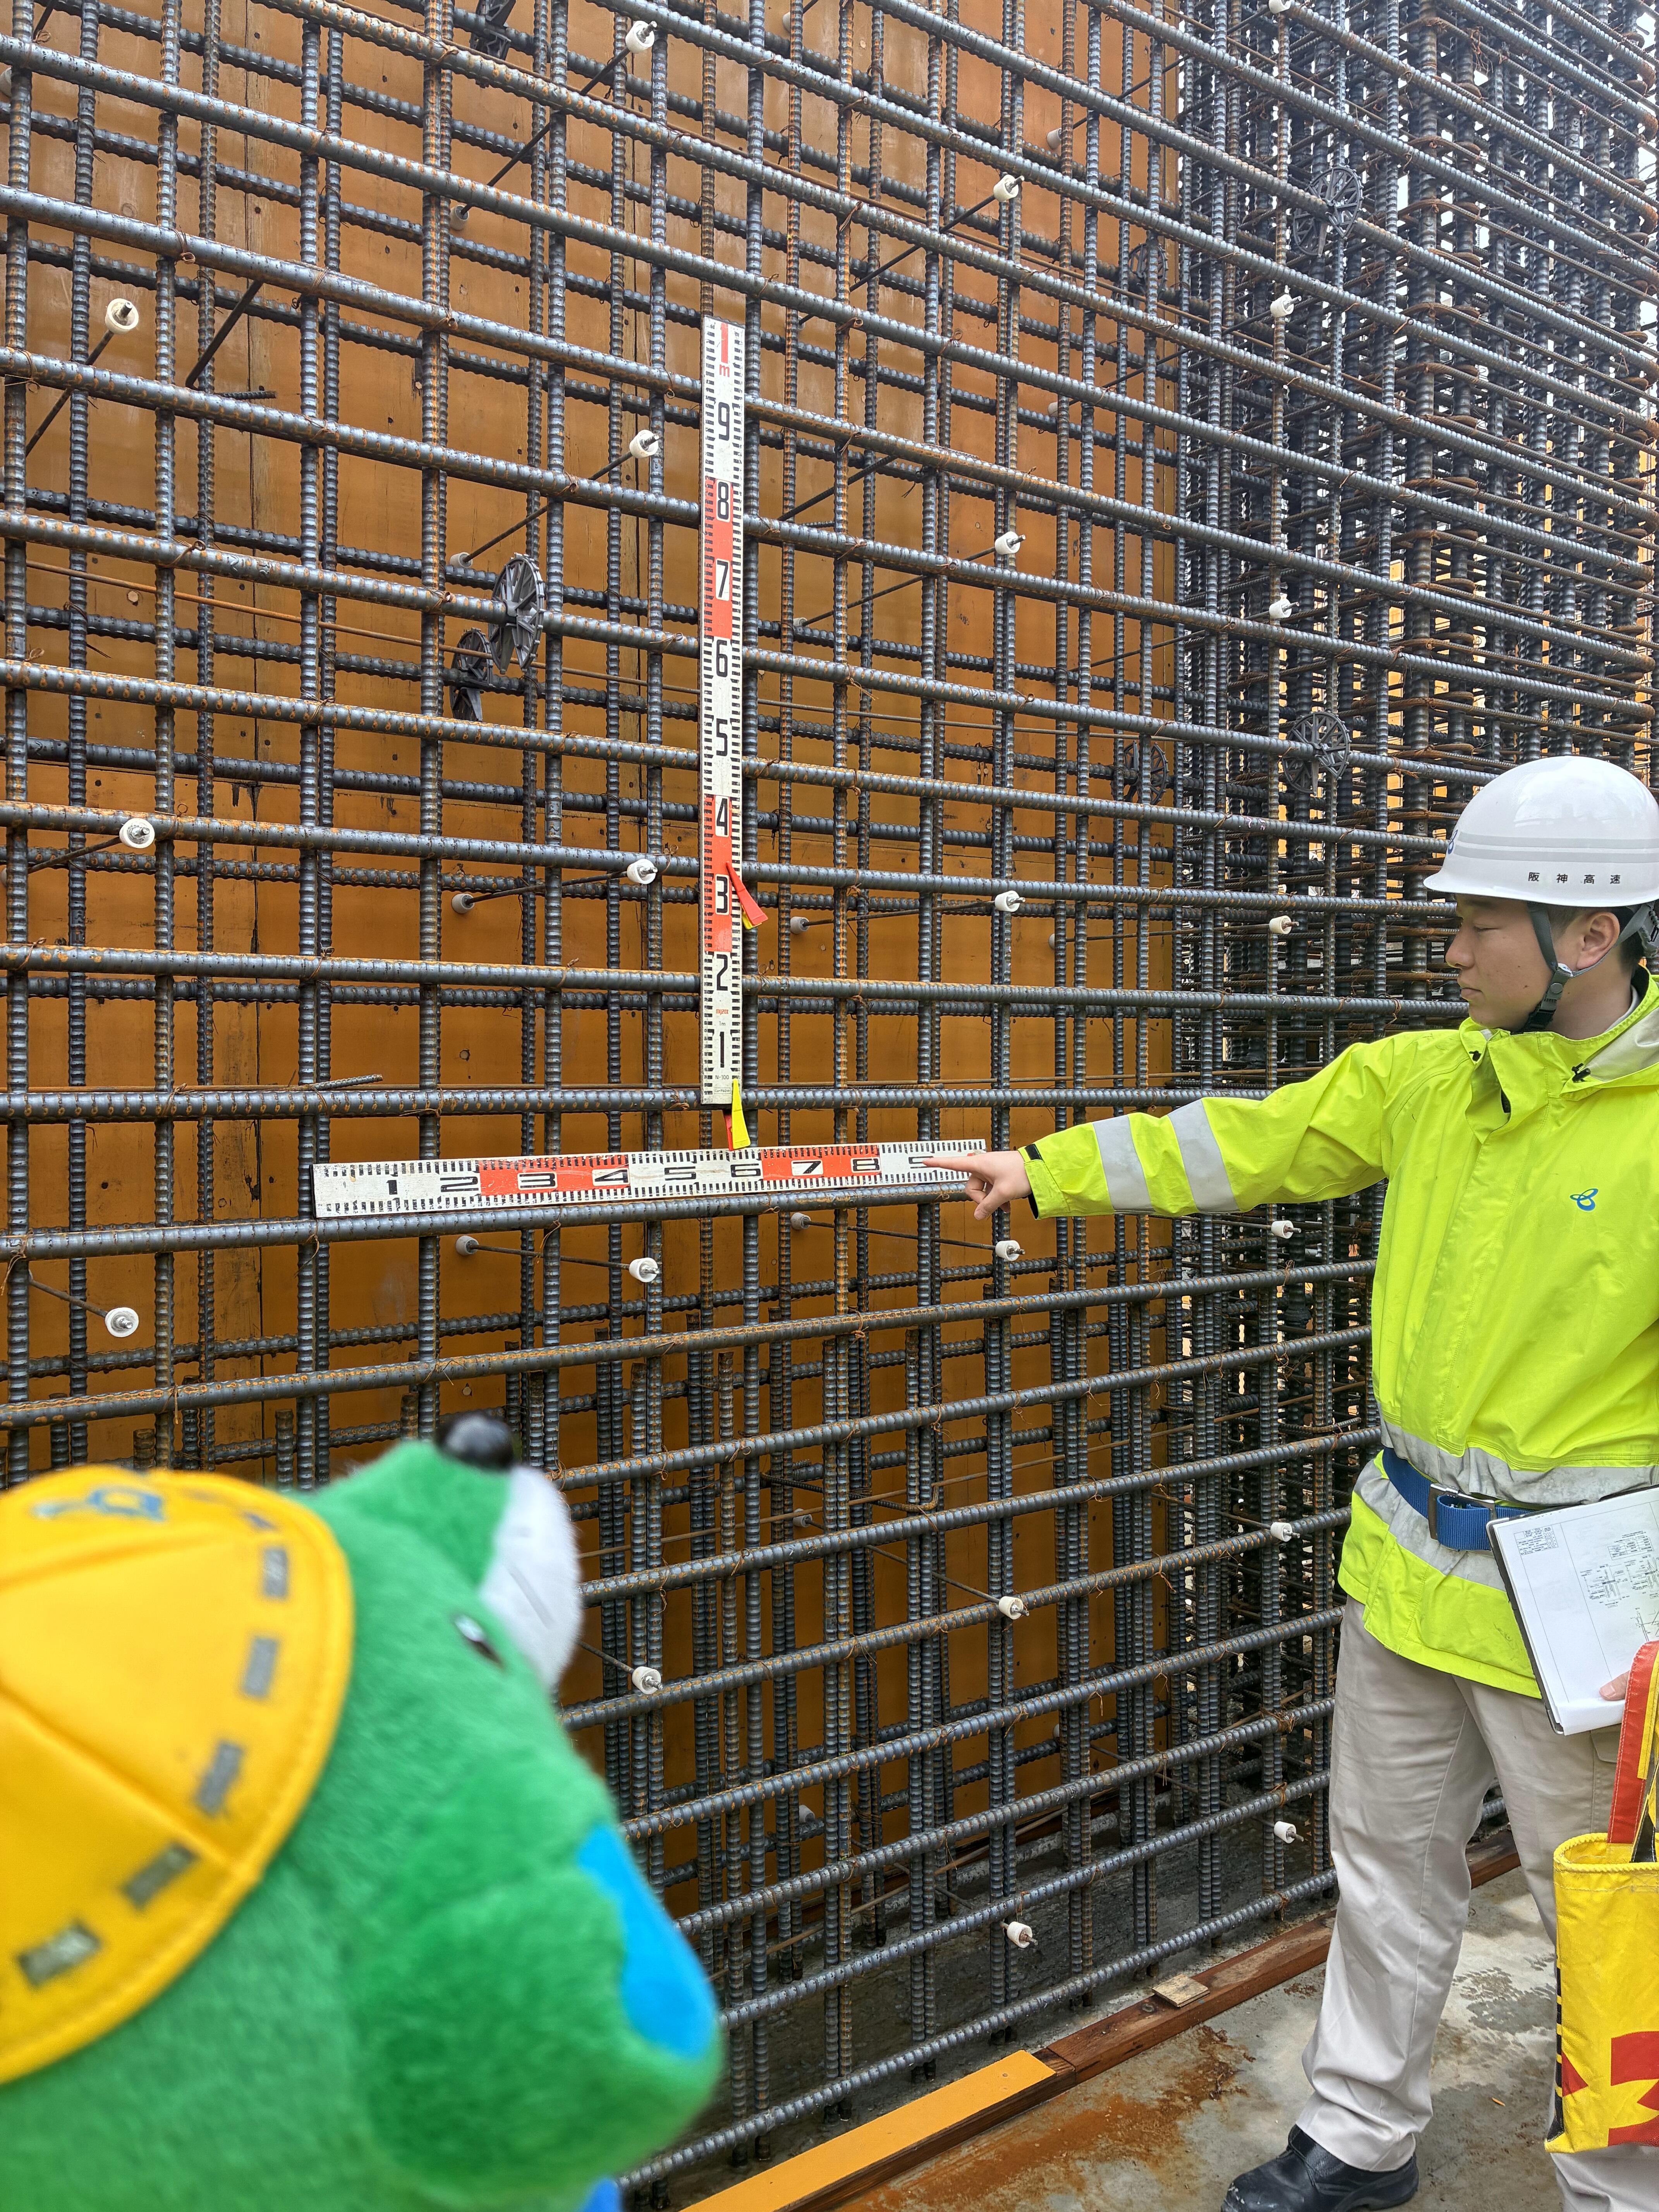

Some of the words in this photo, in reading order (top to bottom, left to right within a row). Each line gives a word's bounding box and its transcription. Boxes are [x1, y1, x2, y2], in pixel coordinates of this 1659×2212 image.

[721, 323, 728, 364] 1
[719, 364, 730, 377] m
[718, 402, 730, 441] 9
[718, 481, 729, 520] 8
[718, 560, 728, 597] 7
[716, 640, 727, 677] 6
[716, 718, 727, 756] 5
[717, 799, 727, 835] 4
[717, 876, 727, 913] 3
[1528, 872, 1621, 884] 阪神高速
[717, 954, 728, 991] 2
[719, 1031, 725, 1068] 1
[387, 1178, 398, 1195] 1
[440, 1176, 478, 1192] 2
[520, 1173, 555, 1188] 3
[595, 1170, 628, 1183] 4
[665, 1166, 696, 1180] 5
[731, 1164, 761, 1177] 6
[793, 1161, 821, 1173] 7
[853, 1158, 880, 1171] 8
